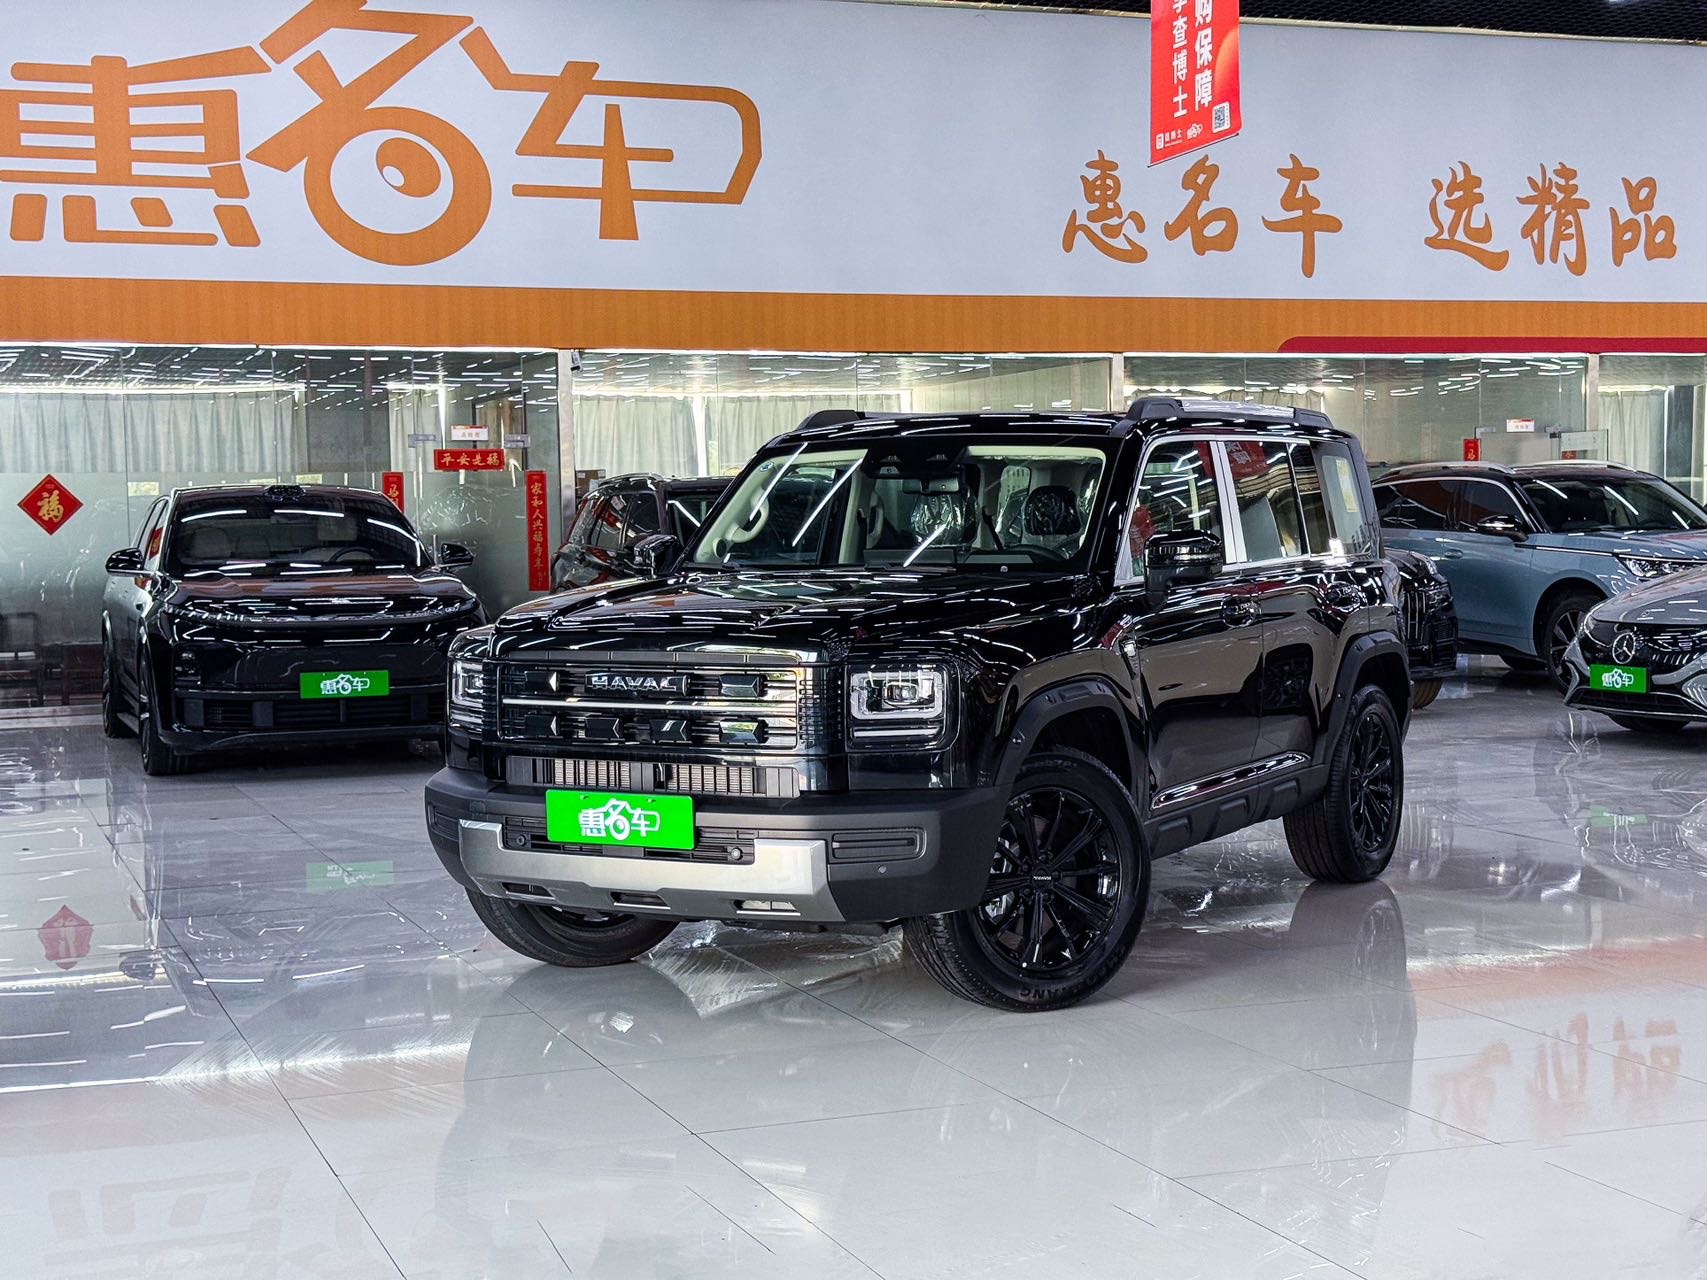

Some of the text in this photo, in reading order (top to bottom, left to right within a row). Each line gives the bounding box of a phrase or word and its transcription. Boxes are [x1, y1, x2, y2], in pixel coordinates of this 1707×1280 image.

[0, 0, 762, 266] 惠名车
[1062, 149, 1677, 278] 惠名车 选精品
[441, 452, 499, 467] 平安是福
[37, 489, 65, 523] 福
[320, 673, 371, 695] 惠名车
[591, 676, 677, 692] HAVAL
[578, 797, 661, 841] 惠名车
